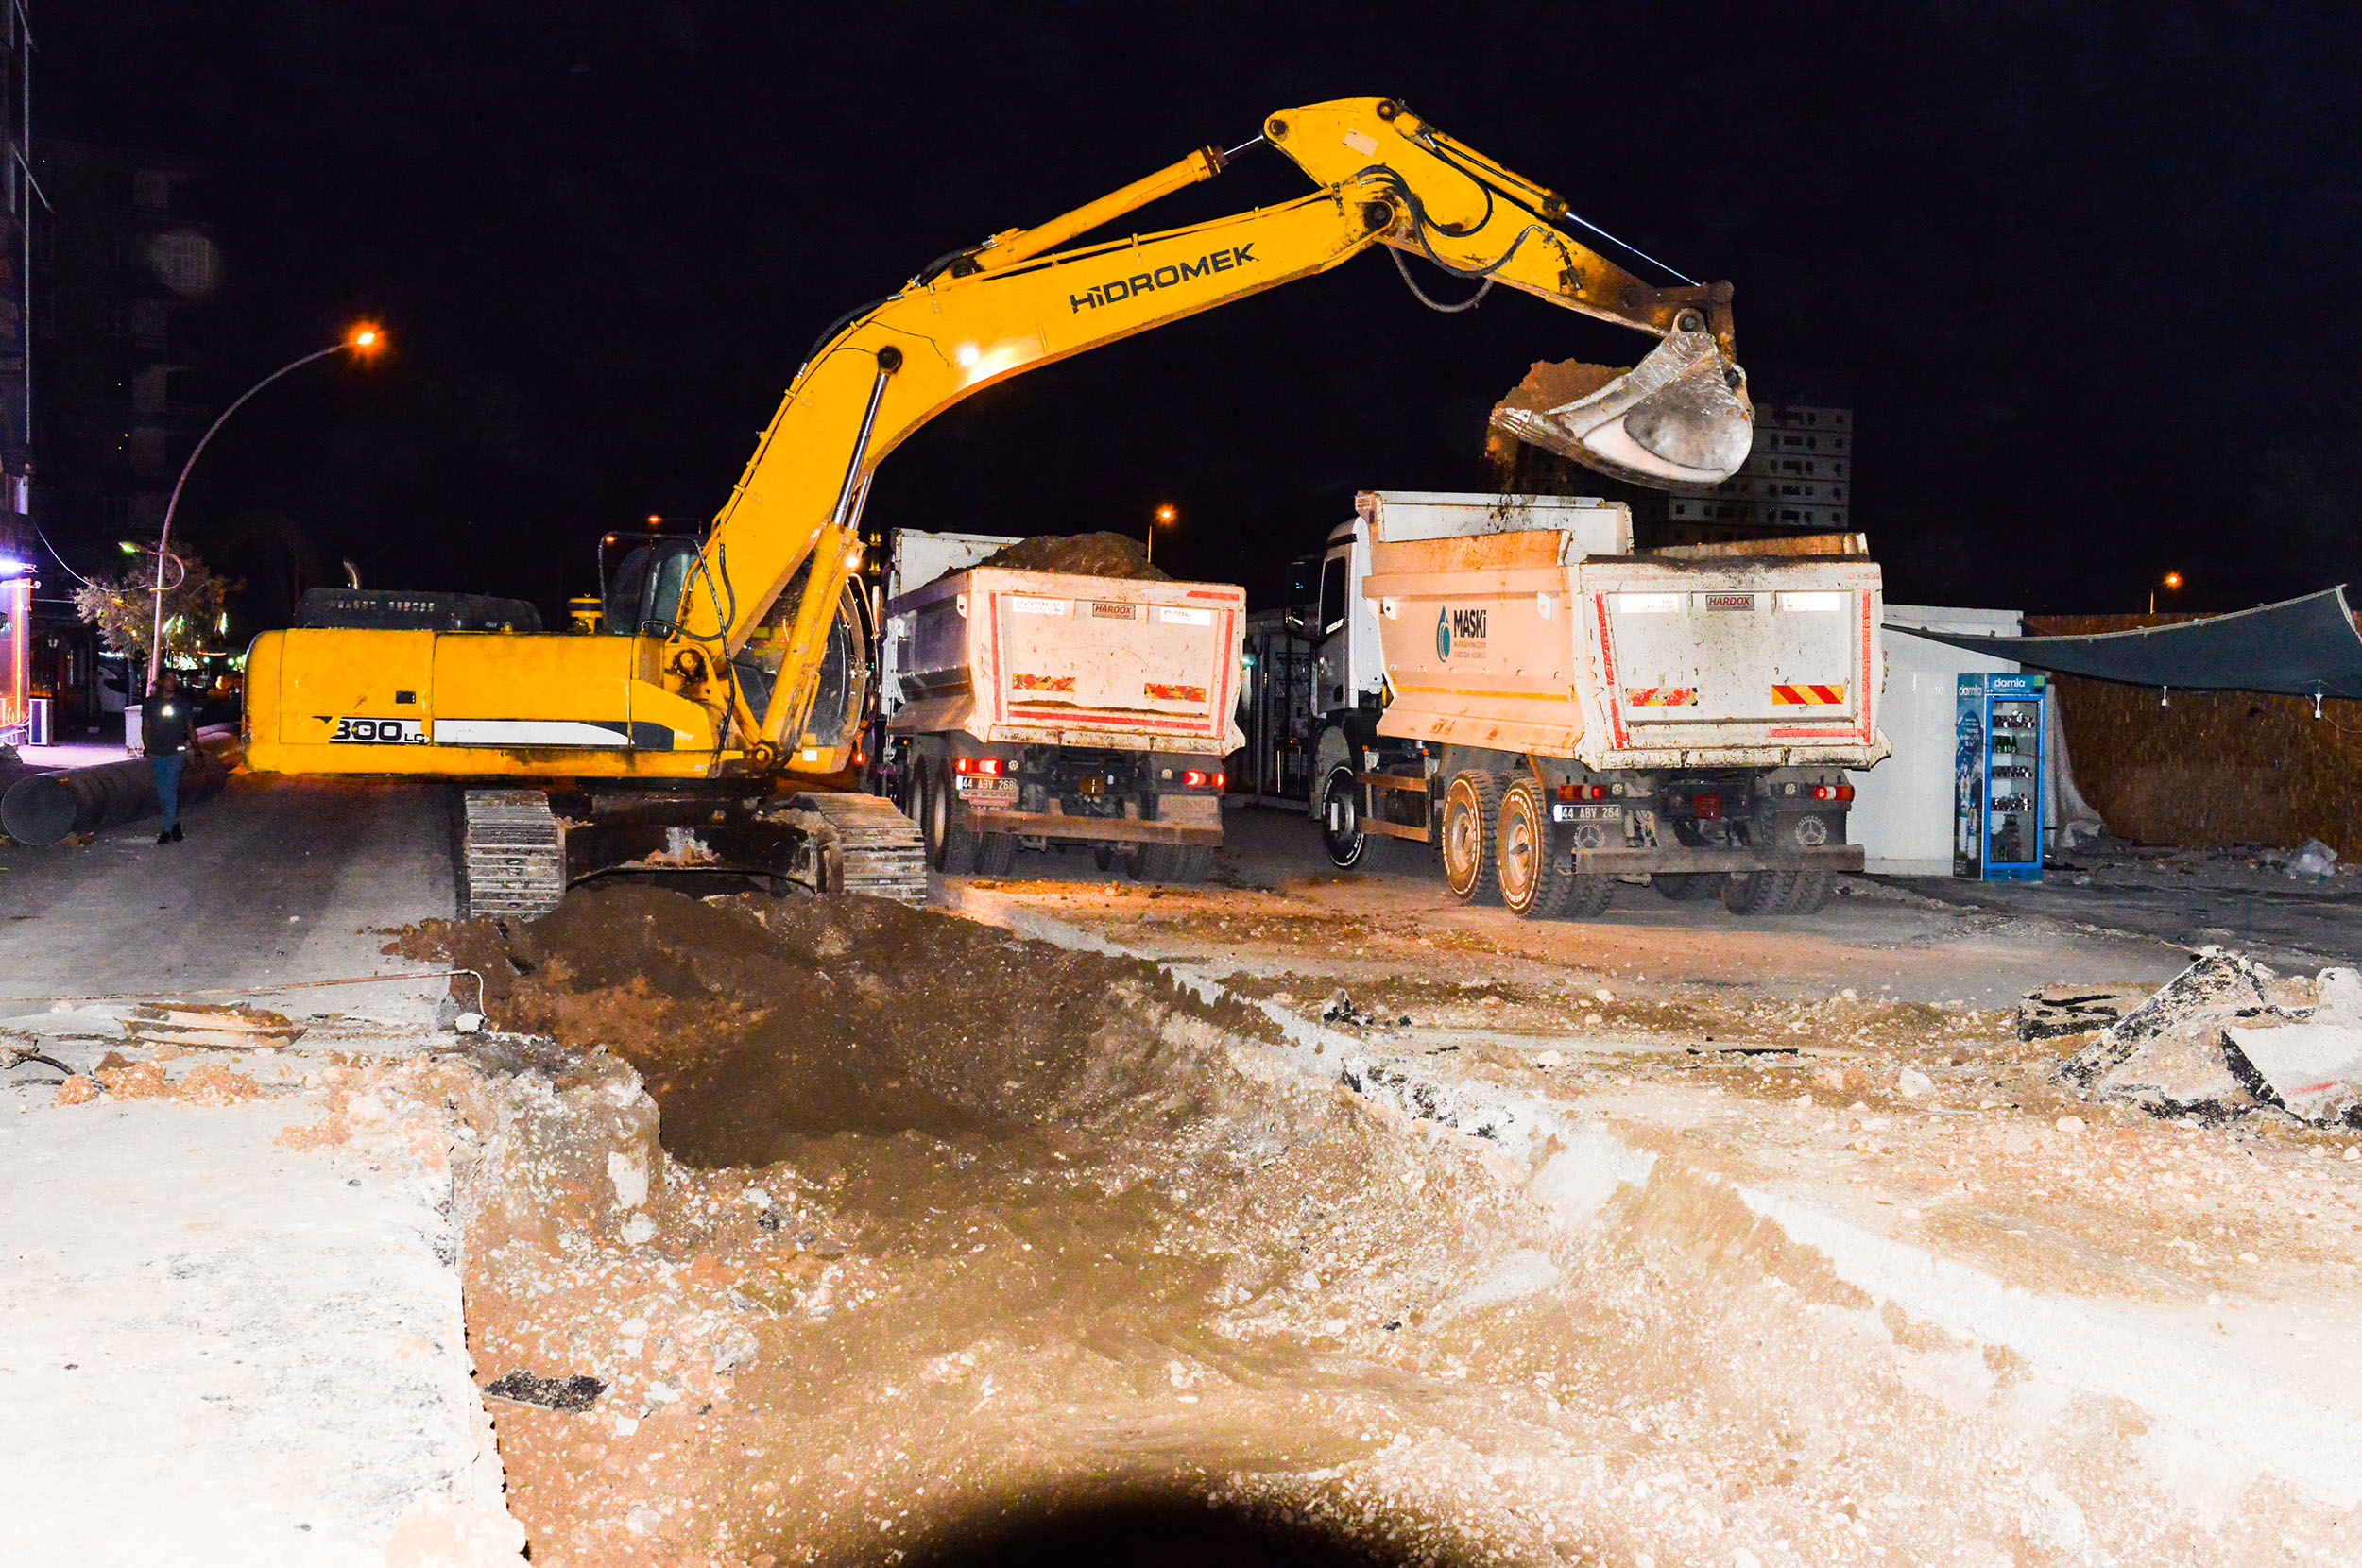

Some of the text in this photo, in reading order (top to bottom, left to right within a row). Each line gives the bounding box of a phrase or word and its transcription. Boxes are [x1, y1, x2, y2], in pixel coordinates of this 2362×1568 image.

[1709, 596, 1750, 605] HARDOX
[1095, 605, 1132, 615] HARDOX
[1994, 677, 2026, 688] damla
[963, 778, 973, 789] 44
[978, 779, 994, 790] ABV
[1563, 807, 1619, 819] 44 ABV 264
